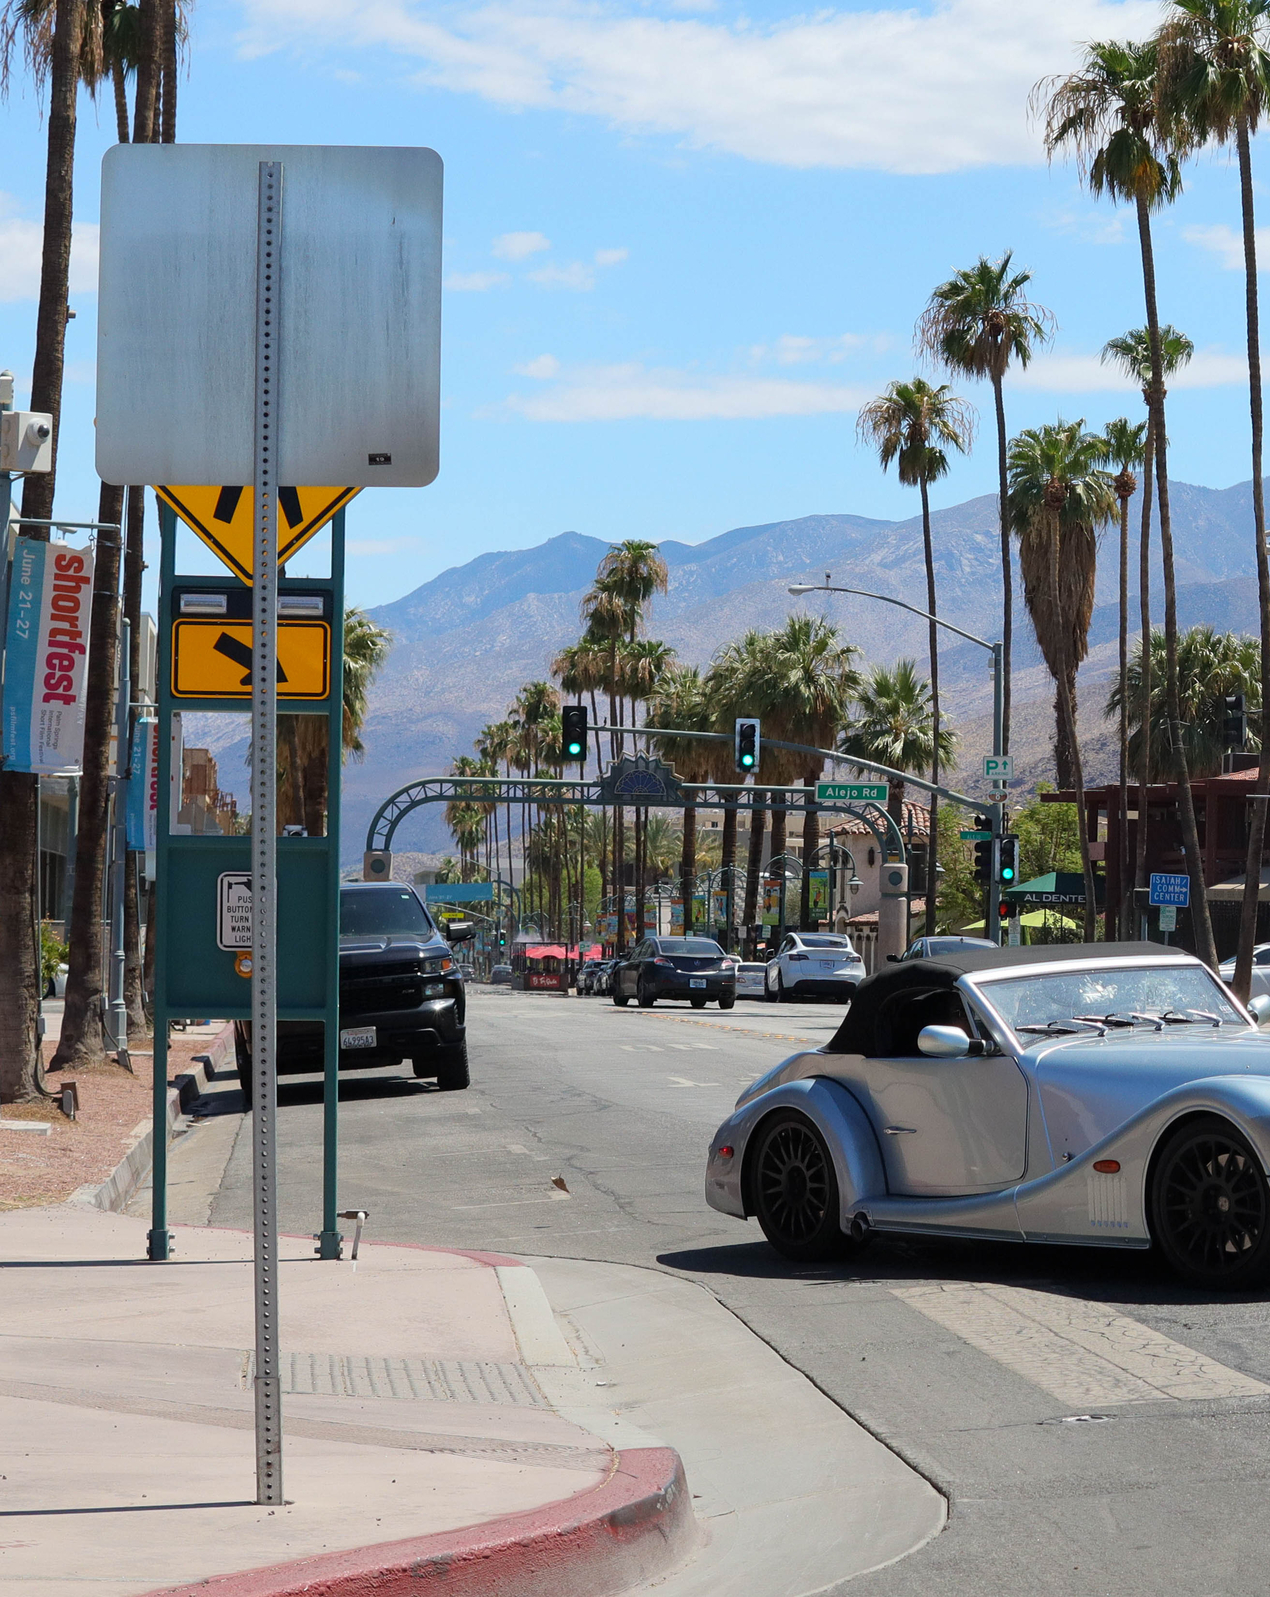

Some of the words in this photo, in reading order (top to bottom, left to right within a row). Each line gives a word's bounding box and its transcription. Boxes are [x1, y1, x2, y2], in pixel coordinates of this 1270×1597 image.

[21, 549, 35, 585] June
[16, 591, 32, 639] 21-27
[42, 553, 90, 706] shortfest
[826, 787, 858, 800] Alejo
[862, 788, 878, 797] Rd
[1157, 884, 1180, 893] COMM
[1024, 894, 1040, 902] AL
[1042, 894, 1086, 902] DENTE
[1154, 892, 1184, 902] CENTER
